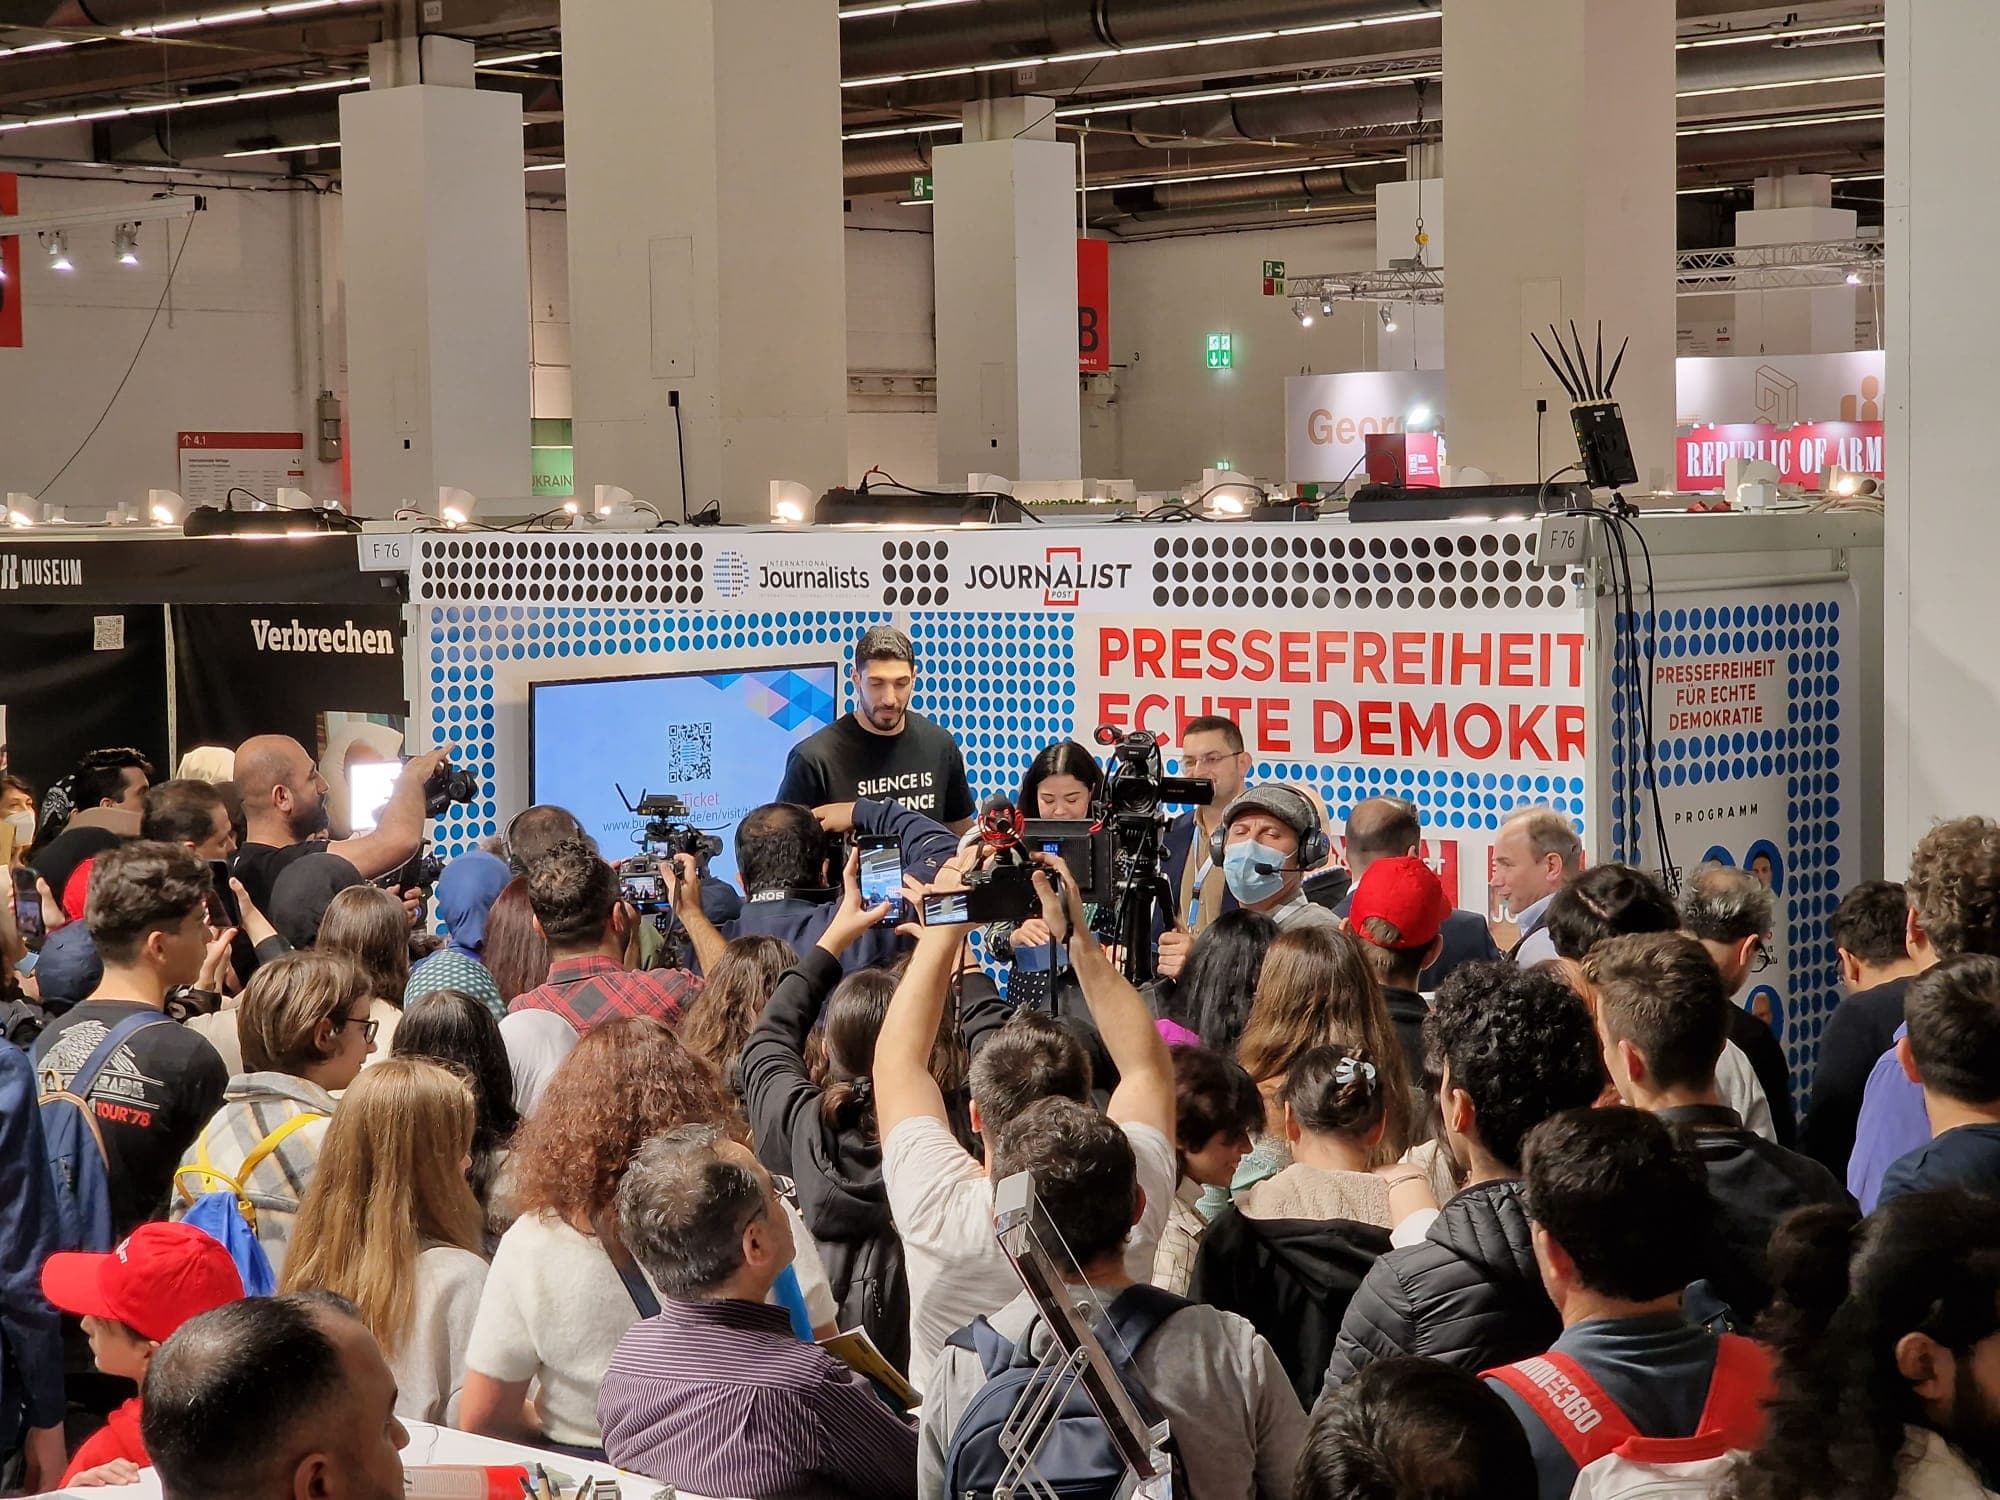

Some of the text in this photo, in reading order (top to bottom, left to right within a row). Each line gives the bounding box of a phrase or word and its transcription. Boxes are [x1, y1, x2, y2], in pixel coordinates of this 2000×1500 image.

[193, 435, 206, 446] 4.1
[373, 543, 400, 558] F 76
[1550, 530, 1575, 549] F 76
[21, 559, 82, 586] MUSEUM
[766, 560, 830, 568] INTERNATIONAL
[759, 566, 870, 589] Journalists
[965, 564, 1132, 590] JOURNALIST
[1051, 591, 1073, 599] POST
[251, 619, 394, 655] Verbrechen
[1099, 627, 1585, 688] PRESSEFREIHEIT
[1656, 659, 1776, 685] PRESSEFREIHEIT
[1676, 684, 1757, 707] FÜR ECHTE
[1098, 692, 1585, 762] ECHTE DEMOKR
[1669, 706, 1764, 731] DEMOKRATIE
[857, 771, 933, 796] SILENCE IS
[682, 791, 720, 809] Ticket
[1675, 803, 1758, 825] PROGRAMM
